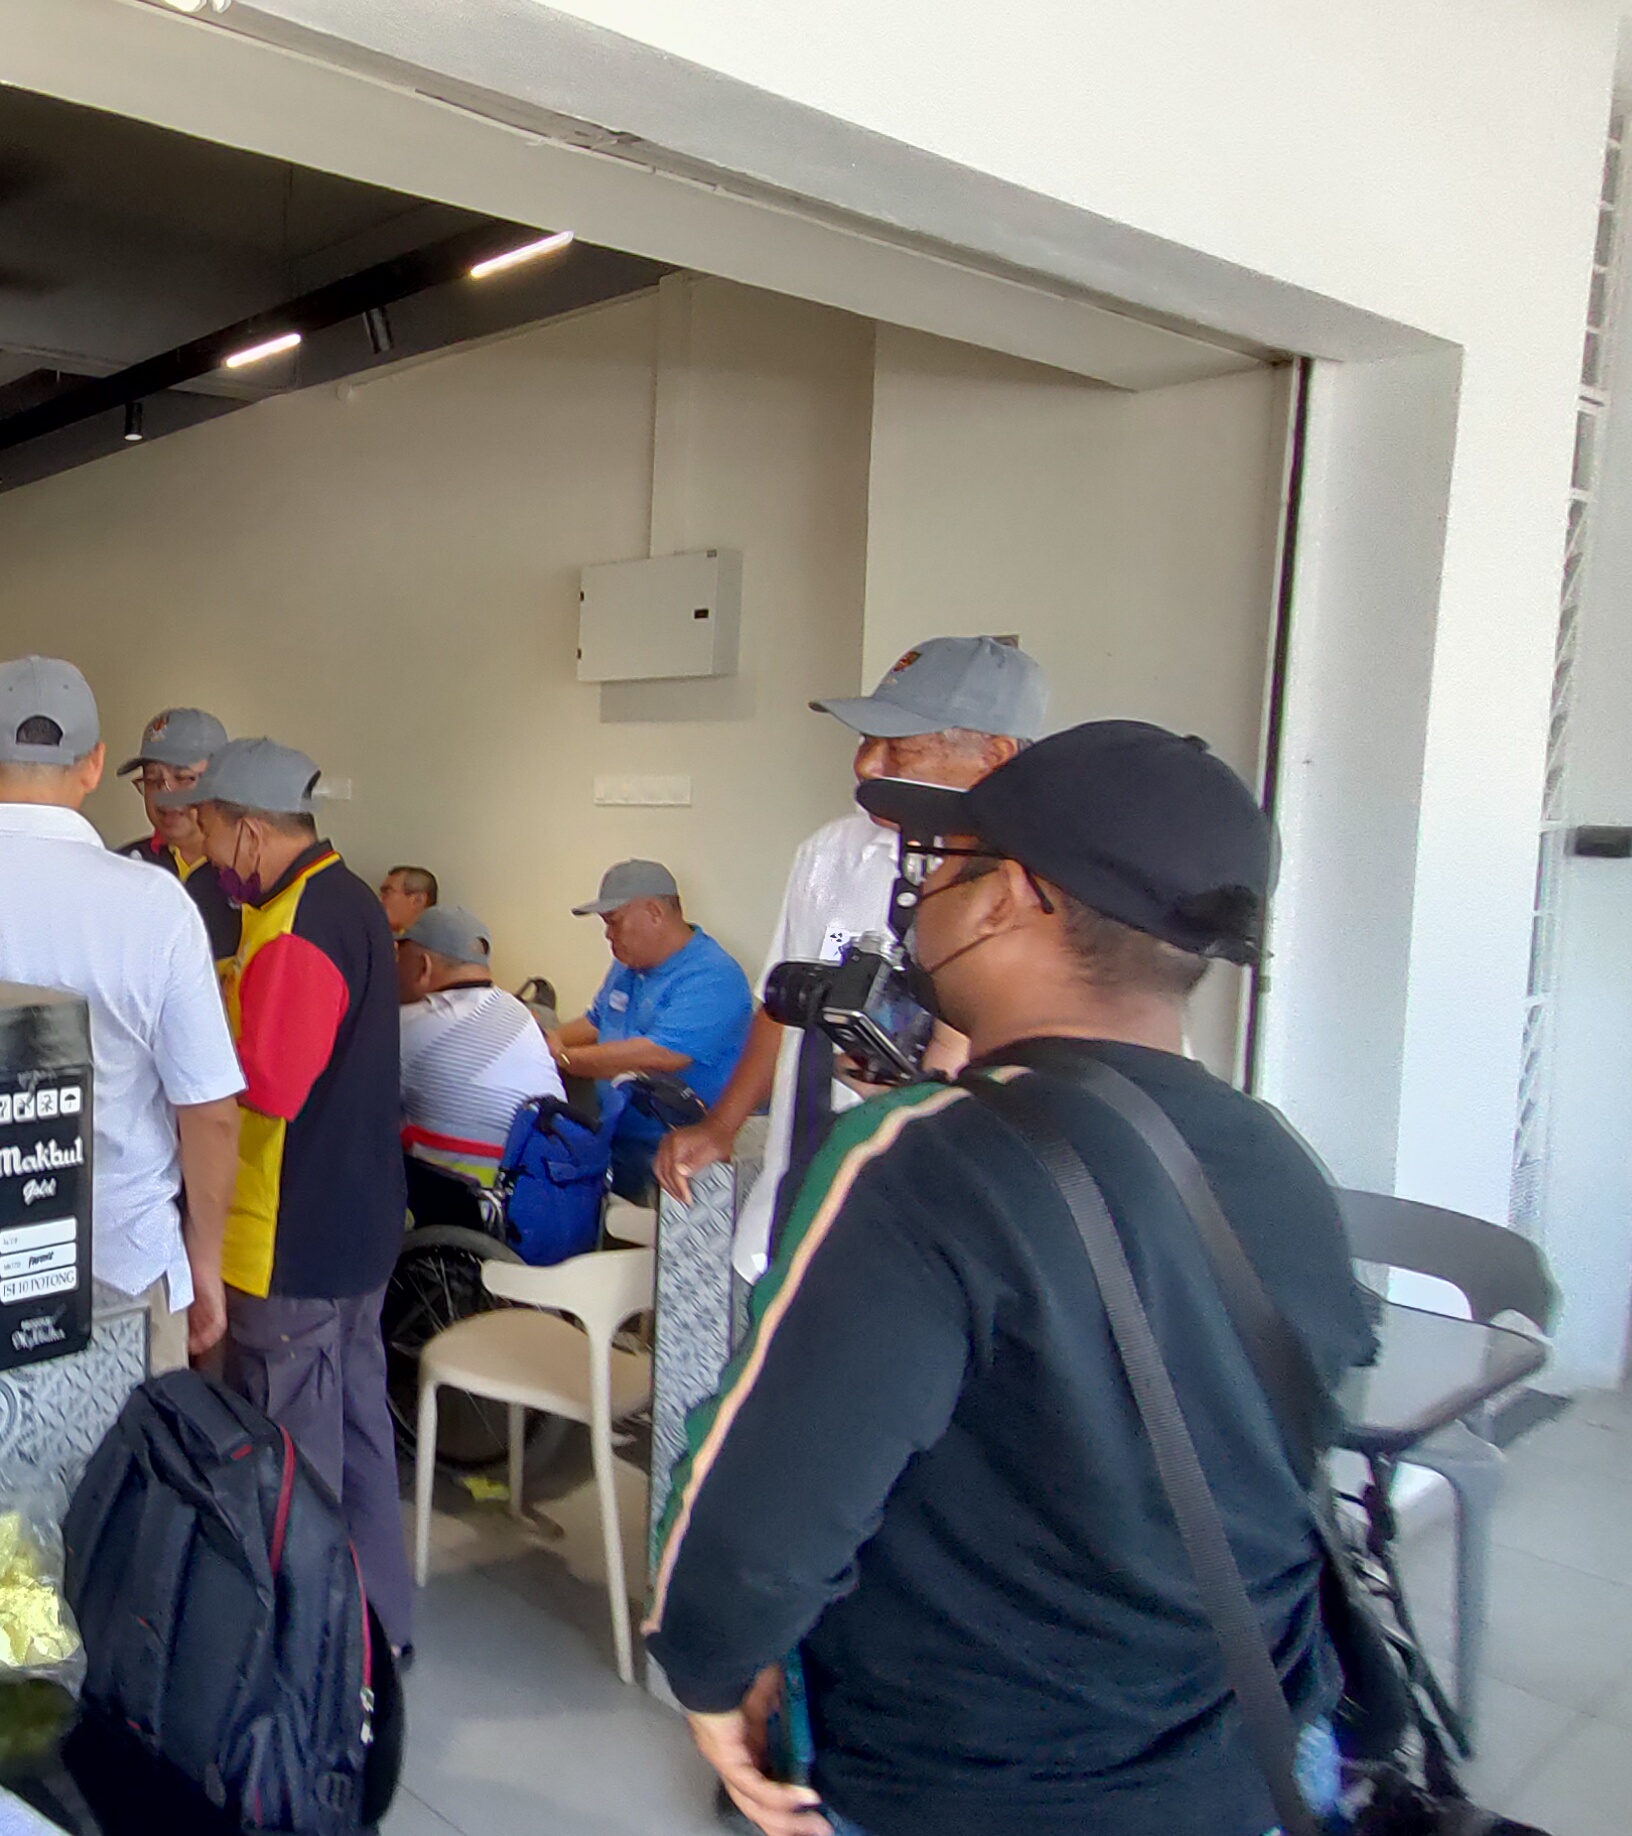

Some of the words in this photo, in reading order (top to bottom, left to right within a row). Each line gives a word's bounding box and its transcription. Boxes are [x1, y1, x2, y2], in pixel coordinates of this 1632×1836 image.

[22, 1178, 57, 1207] Gold
[19, 1280, 29, 1294] 10
[31, 1270, 75, 1291] POTONG
